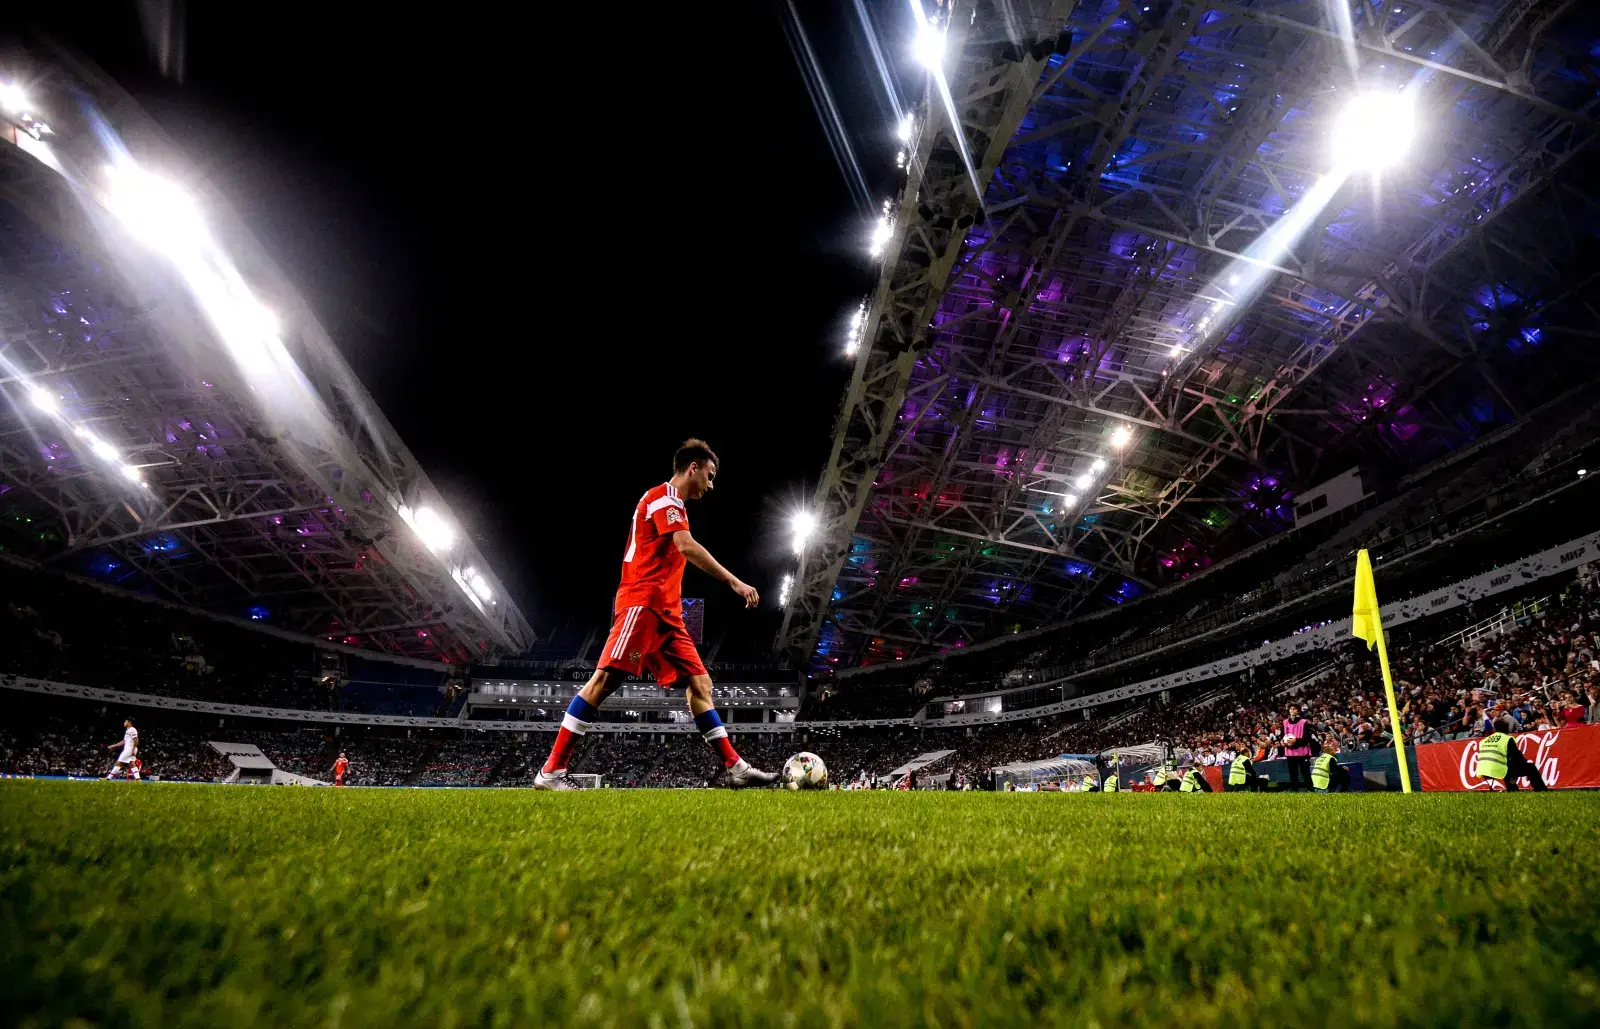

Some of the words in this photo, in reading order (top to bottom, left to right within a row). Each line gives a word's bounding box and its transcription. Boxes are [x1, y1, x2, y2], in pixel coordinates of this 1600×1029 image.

[1560, 547, 1585, 563] МИР
[1490, 574, 1511, 588] МИР
[1431, 596, 1449, 607] МИР
[1335, 629, 1348, 637] МИР
